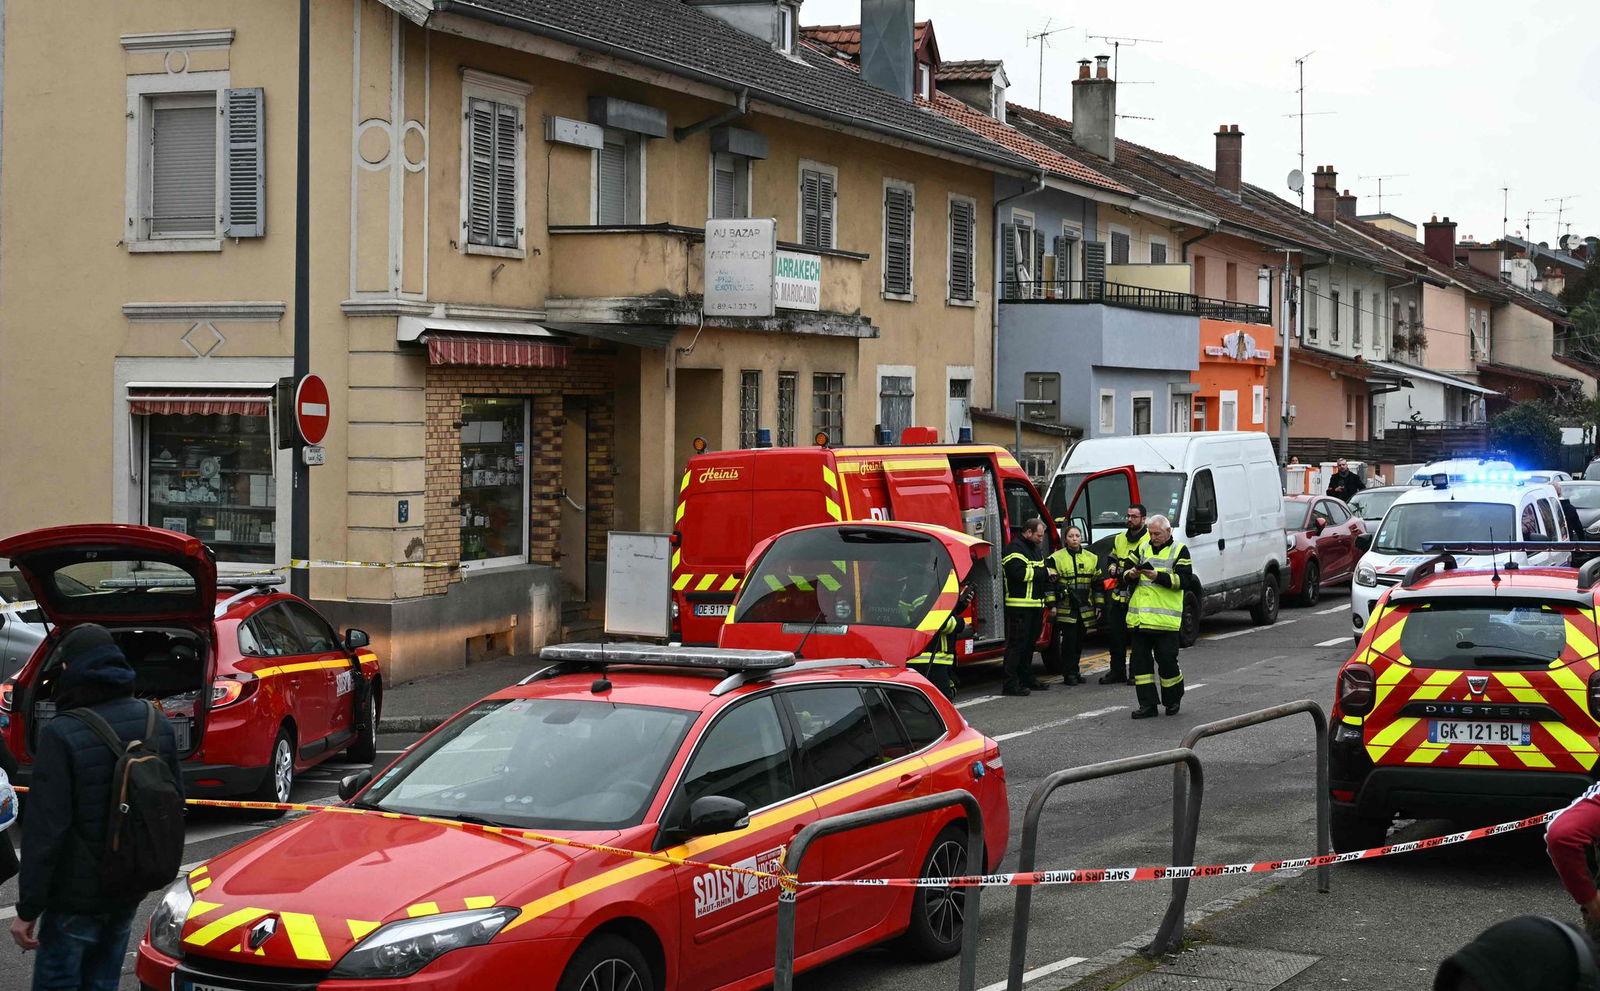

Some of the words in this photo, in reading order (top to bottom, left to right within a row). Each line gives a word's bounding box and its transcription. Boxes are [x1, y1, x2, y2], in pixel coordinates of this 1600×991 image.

[713, 228, 727, 238] AU
[699, 467, 741, 484] Heinis
[1426, 705, 1530, 716] DUSTER
[1032, 872, 1083, 884] POMPIERS
[1085, 870, 1130, 883] SAPEURS
[692, 868, 734, 906] SDIS
[696, 898, 732, 916] HAUT-RHIN
